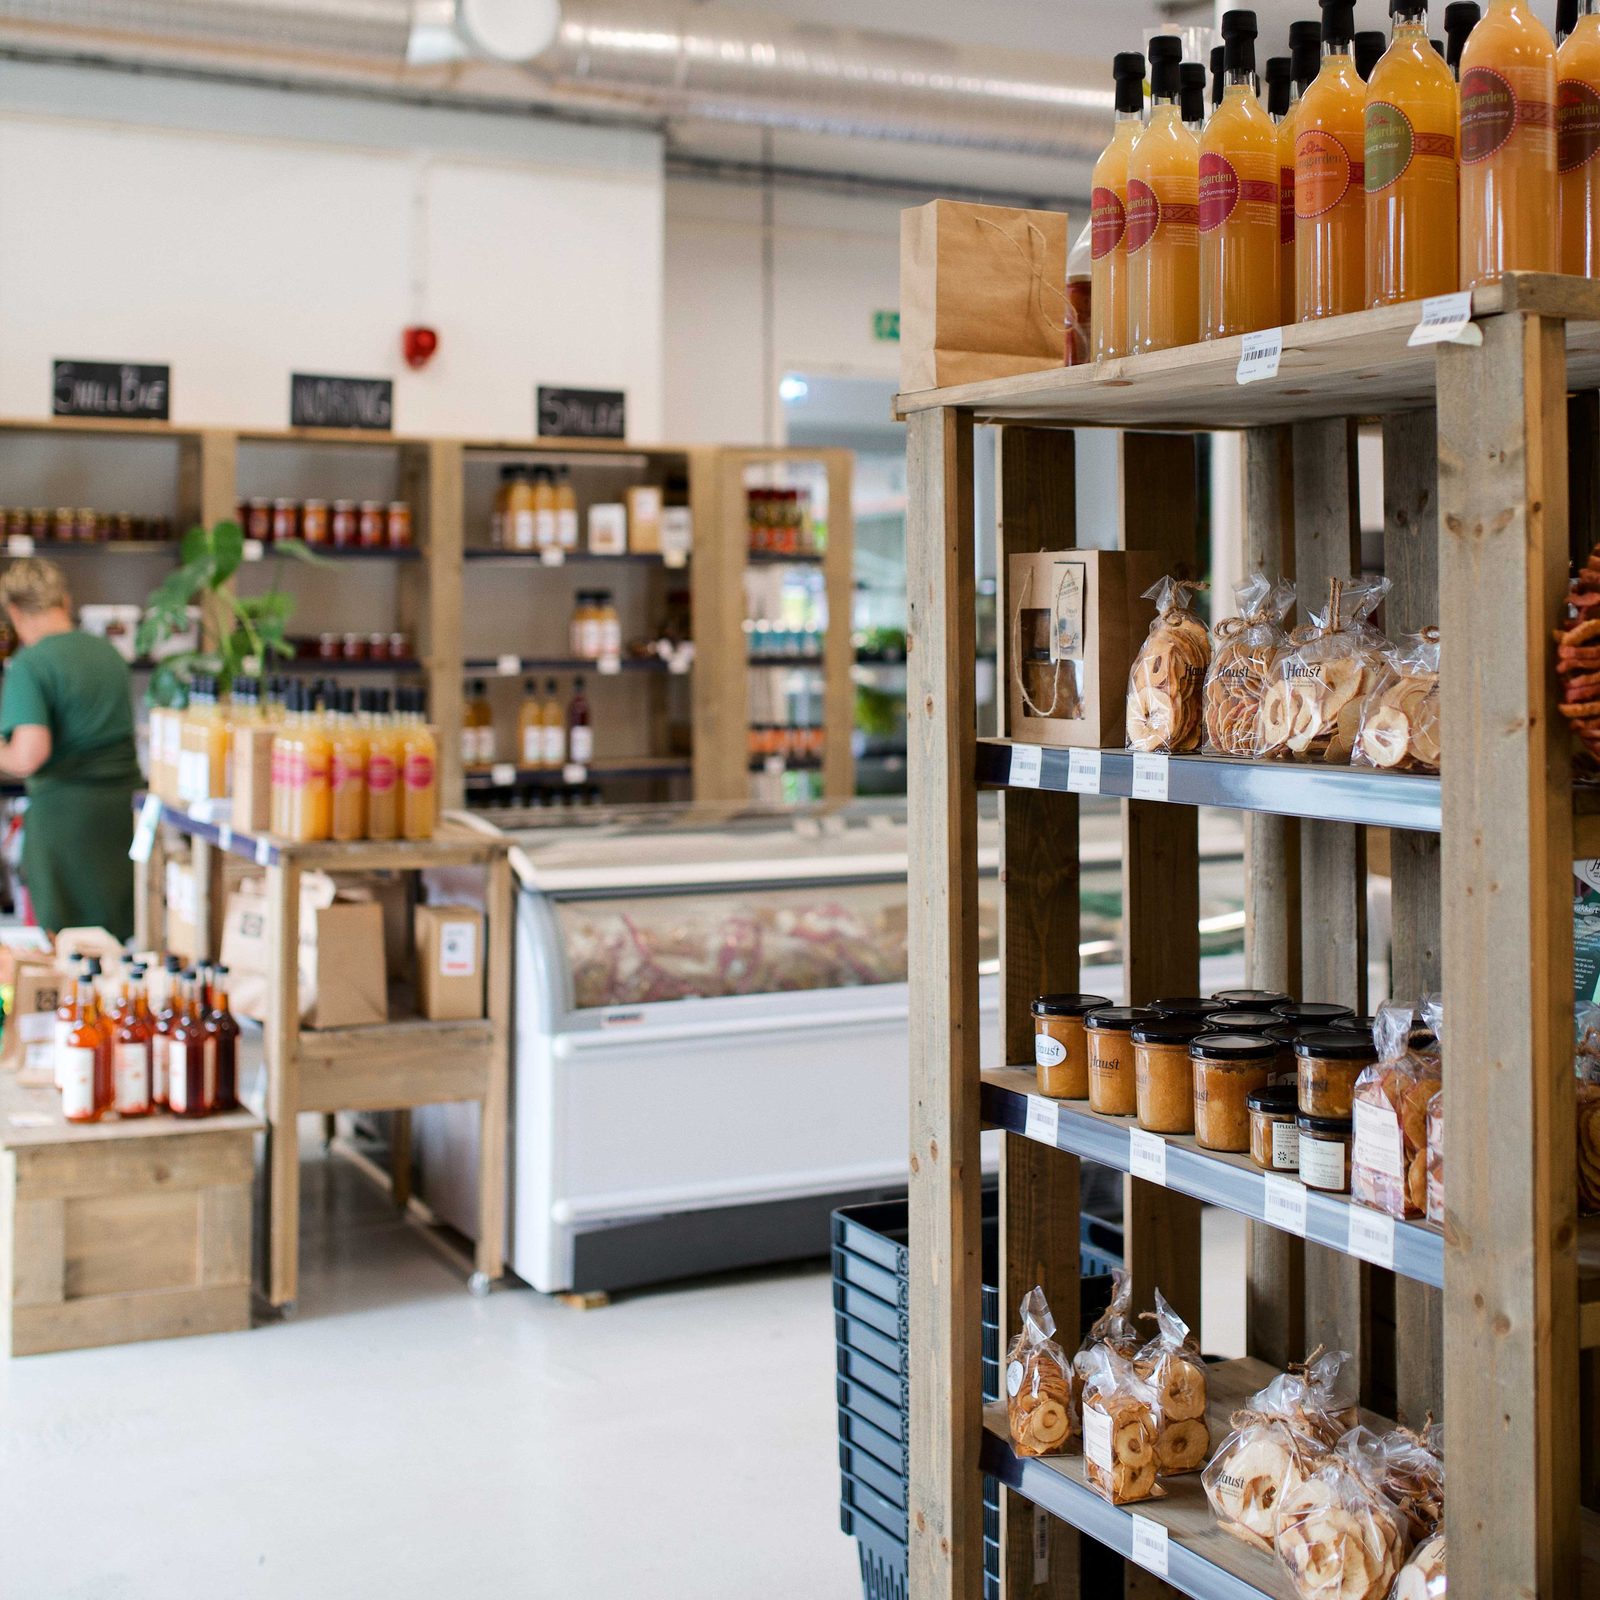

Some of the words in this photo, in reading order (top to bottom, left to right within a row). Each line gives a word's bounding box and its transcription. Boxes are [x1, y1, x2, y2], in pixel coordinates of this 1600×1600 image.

[1463, 90, 1508, 110] garden
[1477, 110, 1509, 119] Discovery
[1558, 102, 1599, 121] garden
[1218, 663, 1250, 679] Haust
[1285, 661, 1321, 680] Haust
